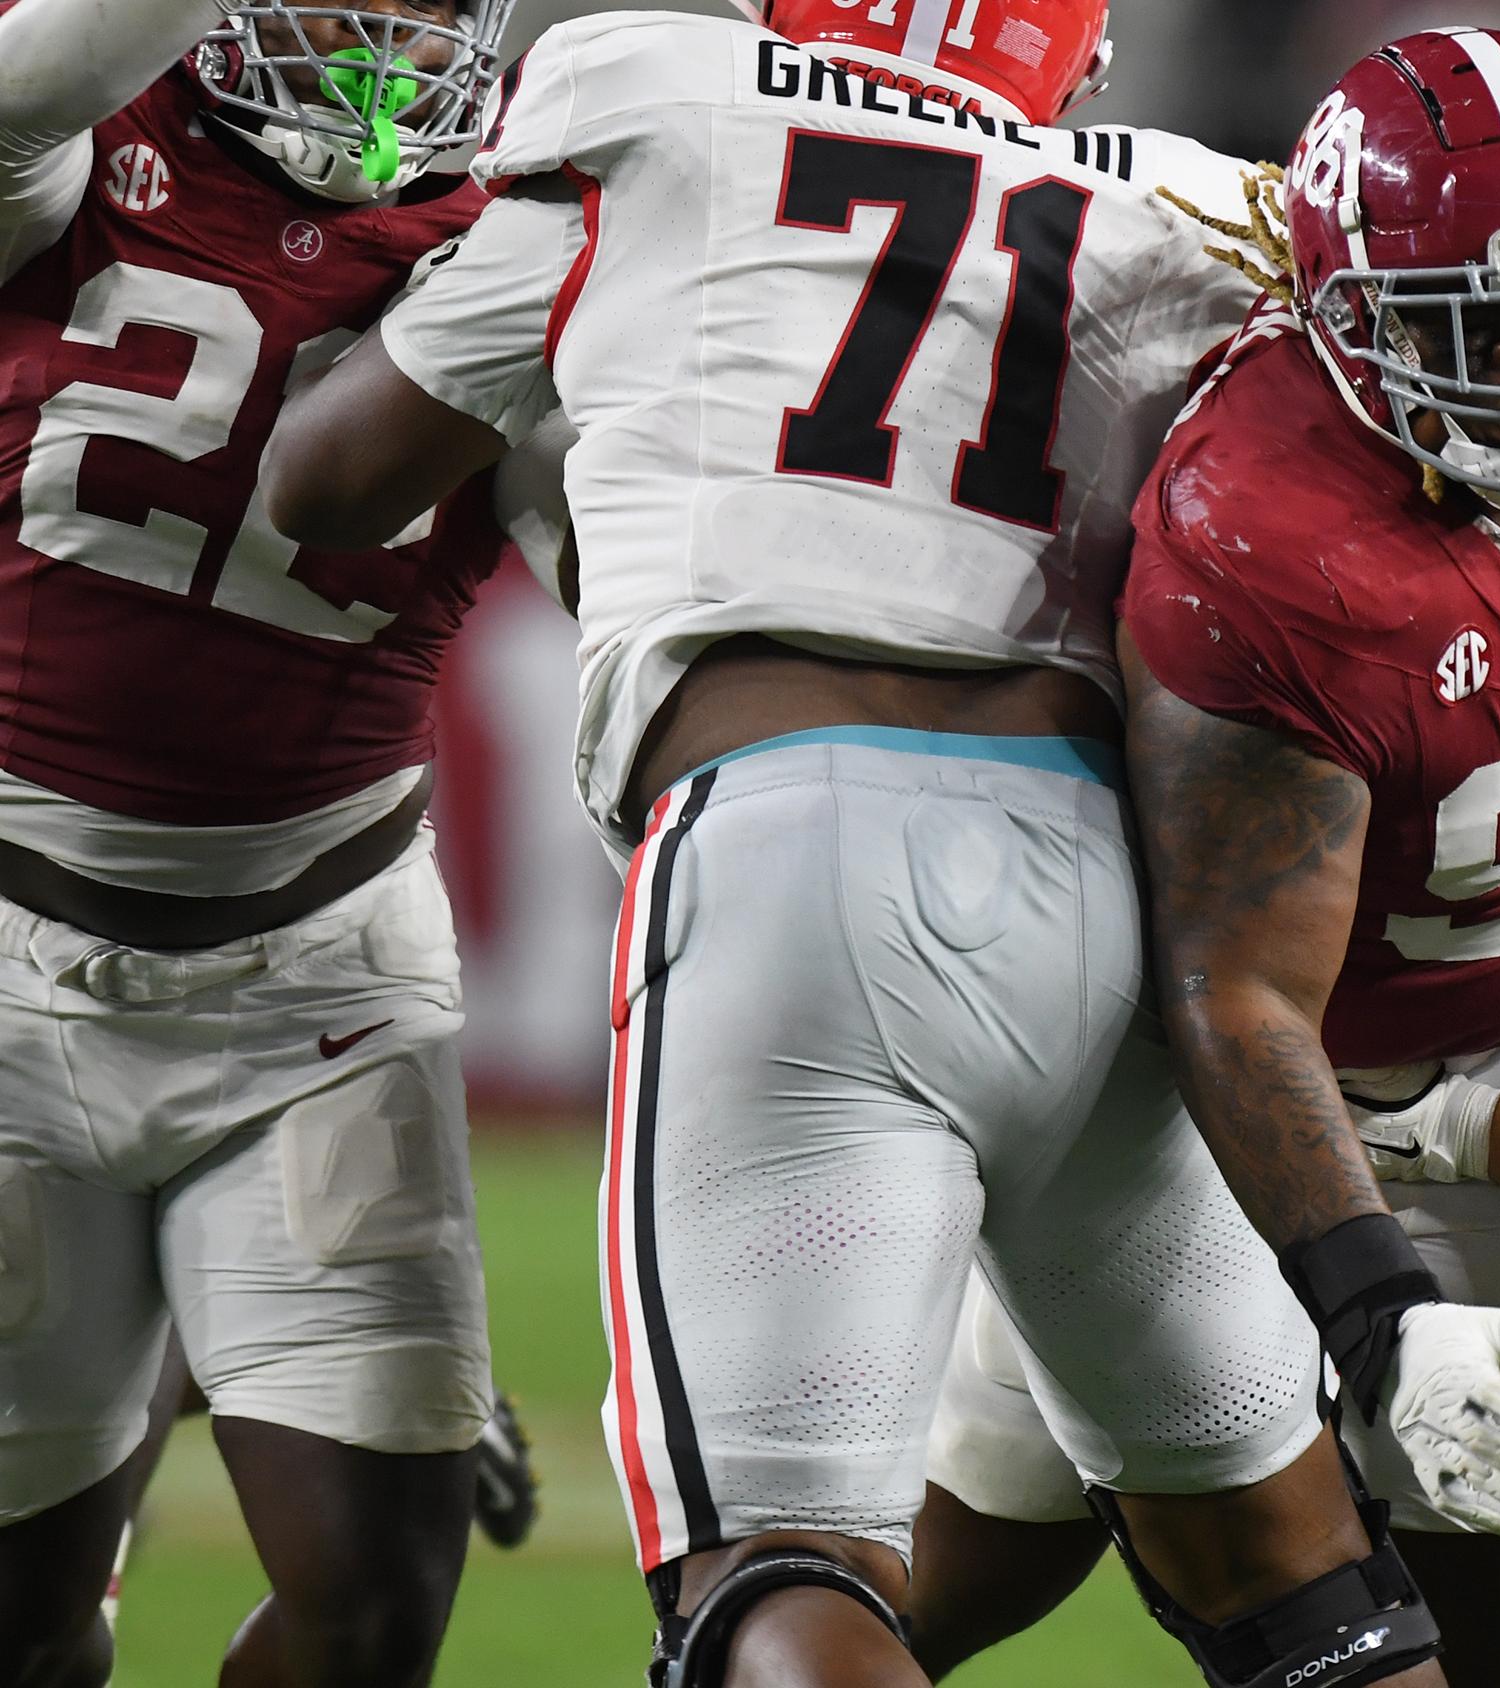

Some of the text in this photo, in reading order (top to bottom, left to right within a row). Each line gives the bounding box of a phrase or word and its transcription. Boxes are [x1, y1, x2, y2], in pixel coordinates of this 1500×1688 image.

[104, 143, 170, 211] SEC
[1291, 90, 1365, 208] 96
[775, 127, 1093, 534] 71
[1395, 334, 1420, 367] TIDE
[1435, 630, 1490, 702] SEC
[1286, 1626, 1391, 1687] DONJOY
